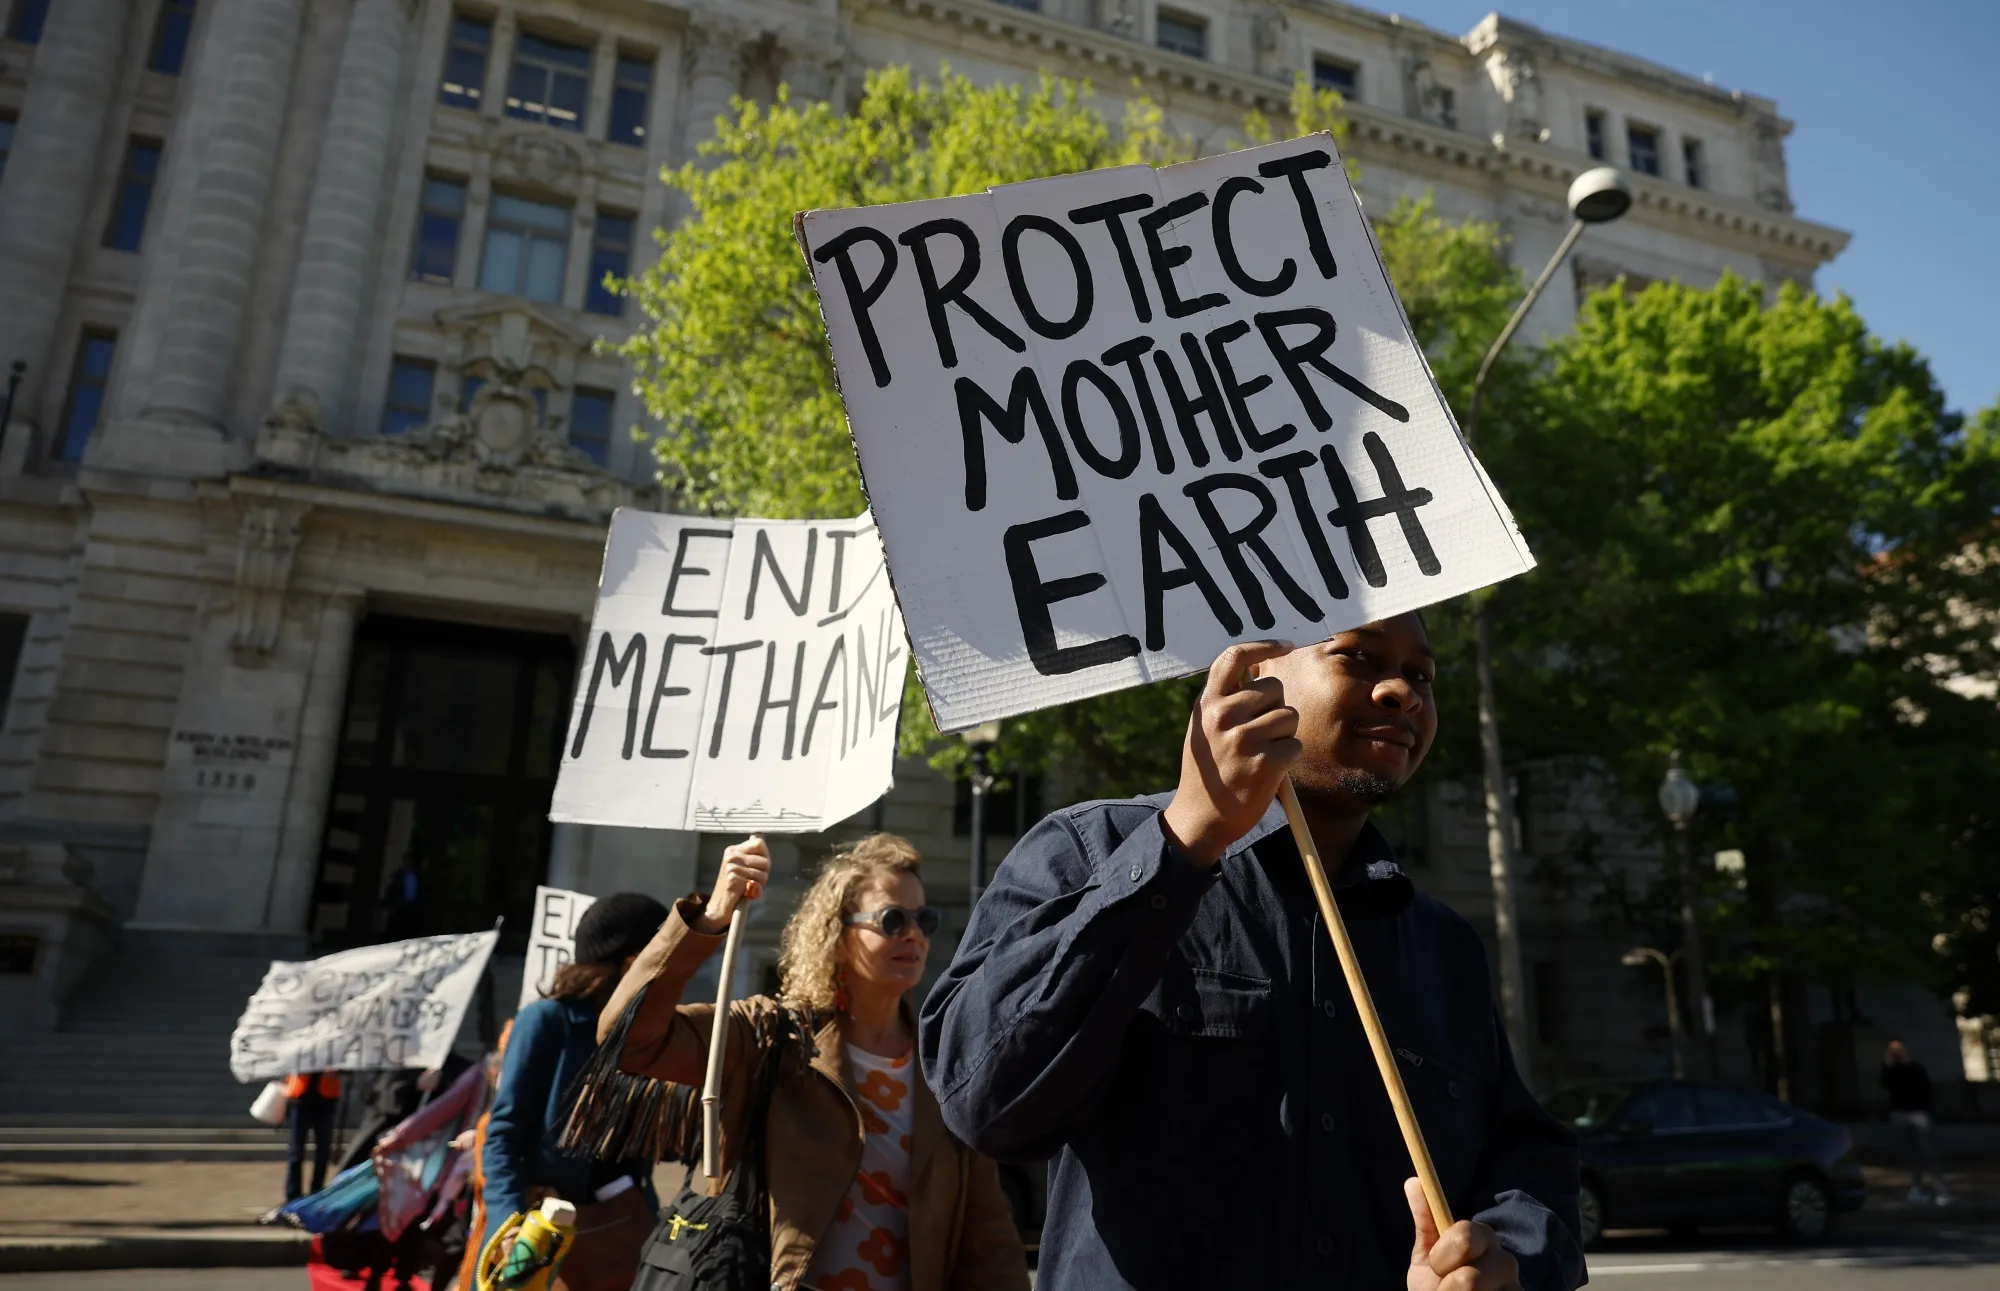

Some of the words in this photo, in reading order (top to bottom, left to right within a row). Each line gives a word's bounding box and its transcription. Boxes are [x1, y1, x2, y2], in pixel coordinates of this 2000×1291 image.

[813, 149, 1338, 388] PROTECT
[954, 306, 1410, 512] MOTHER
[661, 527, 884, 628] END
[1003, 431, 1442, 676] EARTH
[571, 602, 902, 762] METHANE
